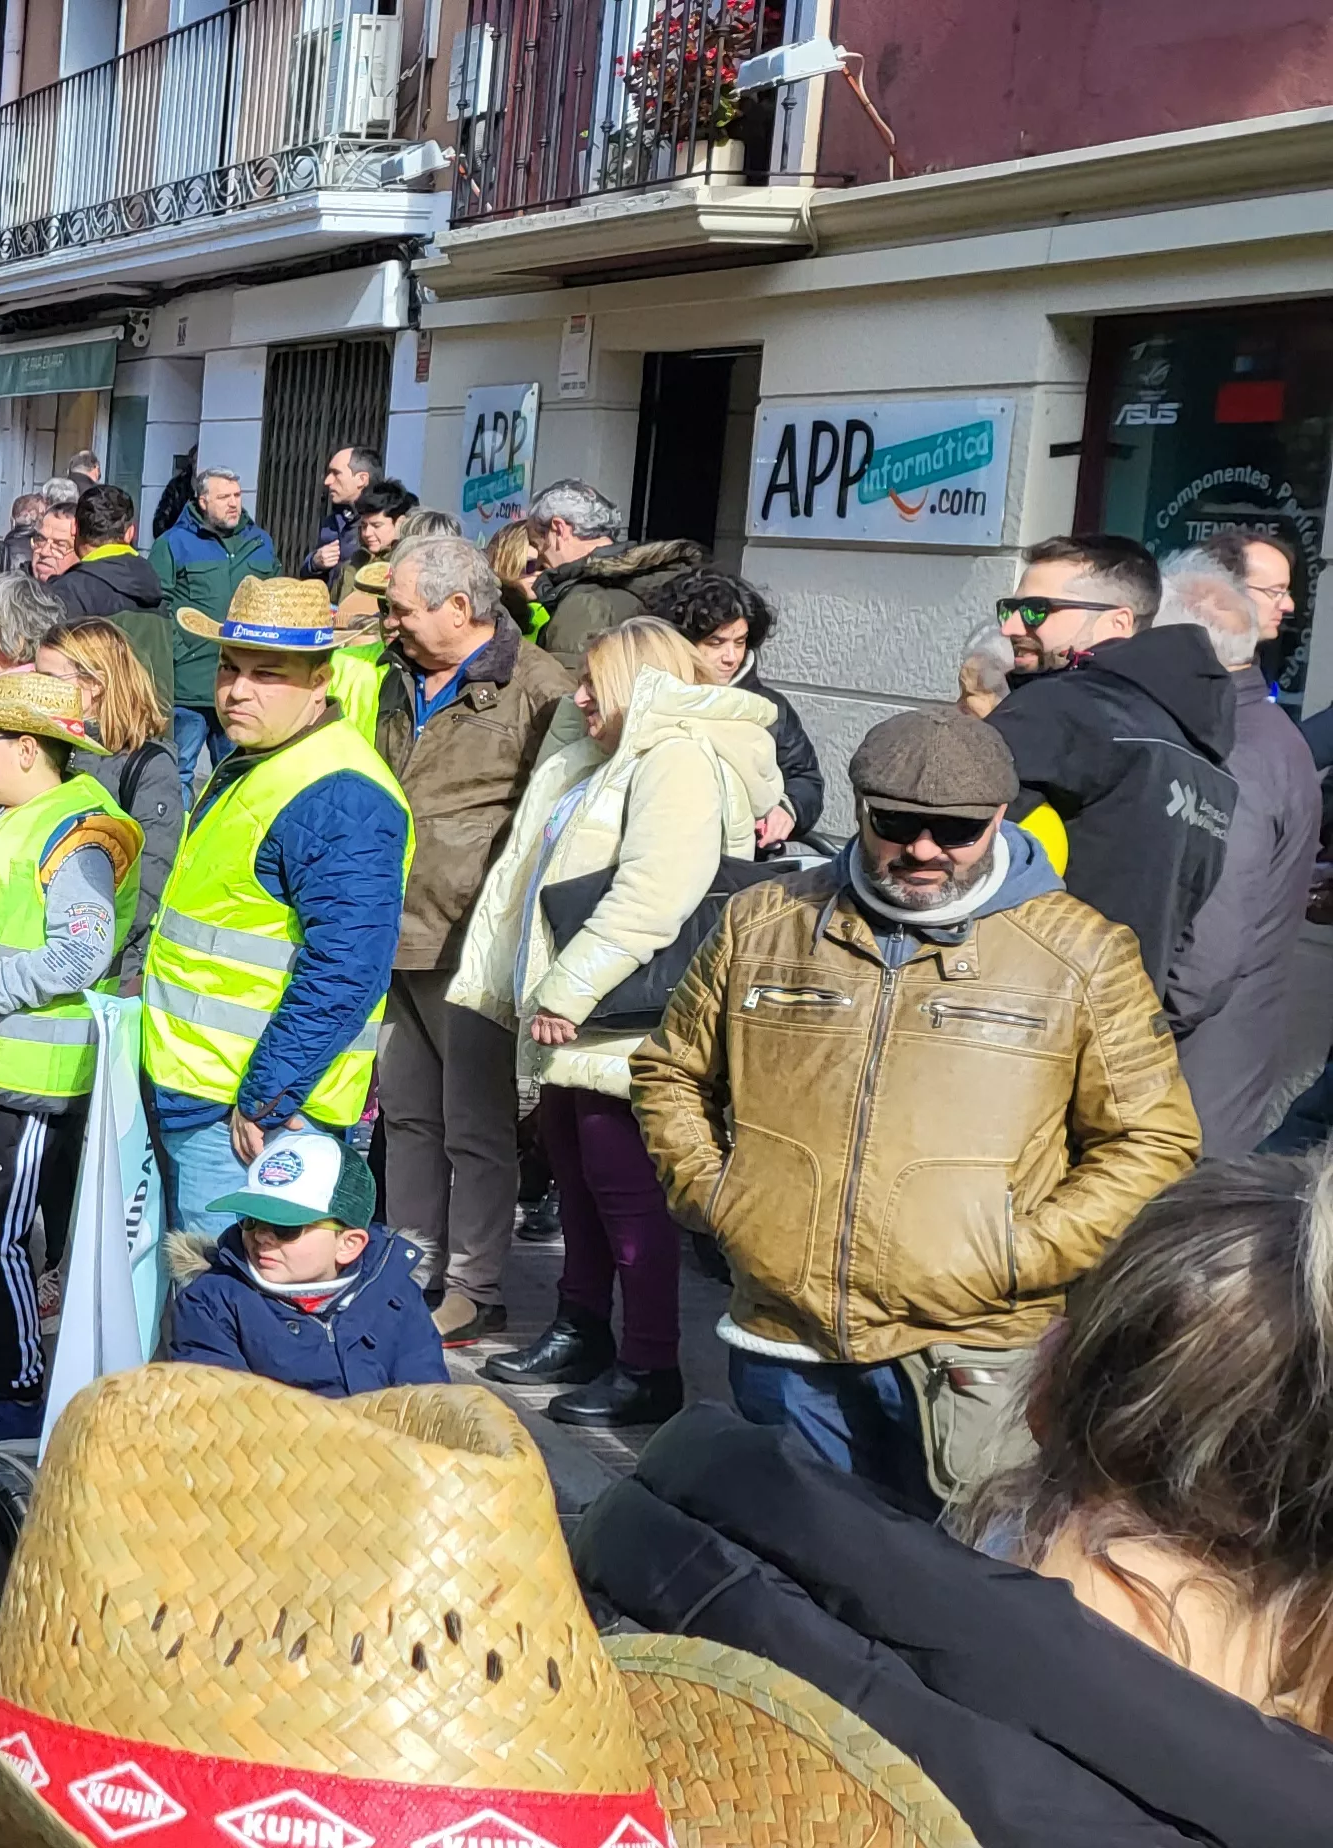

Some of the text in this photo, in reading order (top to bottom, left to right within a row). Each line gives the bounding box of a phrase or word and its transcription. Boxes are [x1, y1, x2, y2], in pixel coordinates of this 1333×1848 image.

[1115, 402, 1182, 426] ASUS
[465, 409, 528, 477] APP
[862, 429, 991, 495] informática
[761, 418, 875, 521] APP
[495, 501, 522, 520] .com
[929, 487, 987, 517] .com
[1156, 464, 1273, 529] Componentes,
[84, 1781, 164, 1821] KUHN
[242, 1812, 345, 1848] KUHN
